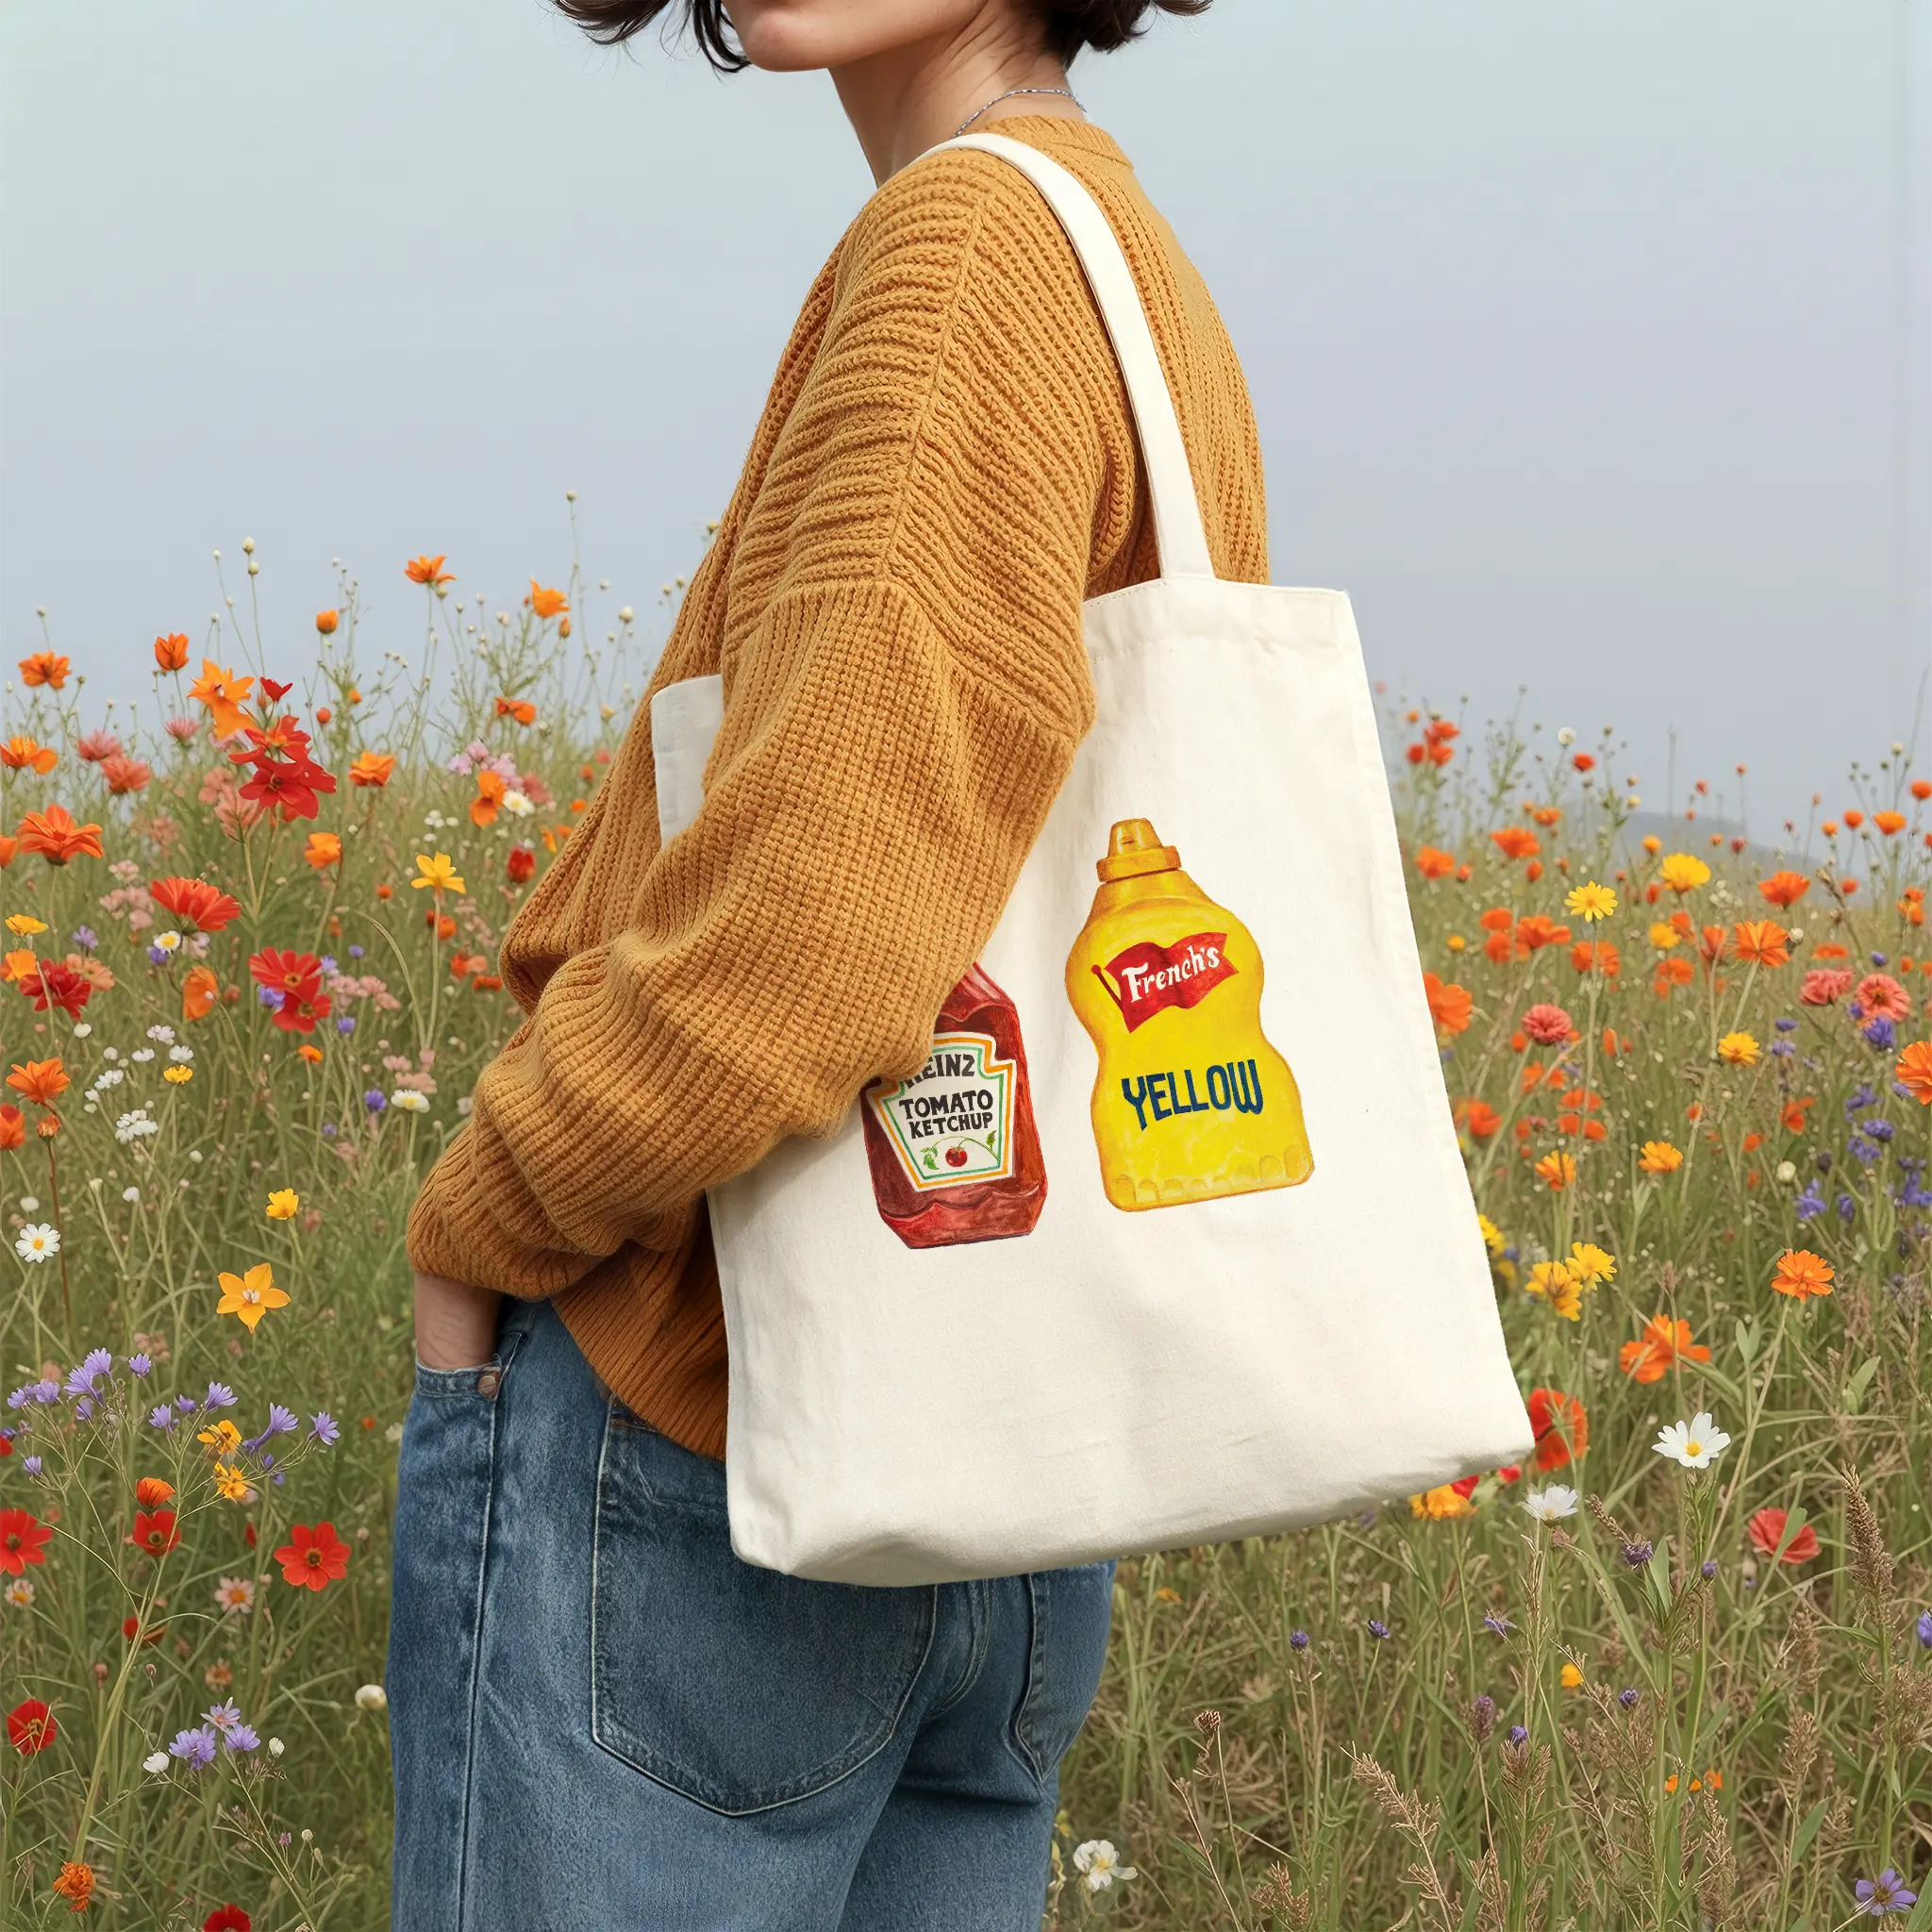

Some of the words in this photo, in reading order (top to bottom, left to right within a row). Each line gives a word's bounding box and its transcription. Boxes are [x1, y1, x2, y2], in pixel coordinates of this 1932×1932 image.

[1121, 945, 1221, 1003] French's
[898, 1089, 993, 1120] TOMATO
[1121, 1058, 1264, 1131] YELLOW
[908, 1112, 993, 1140] KETCHUP
